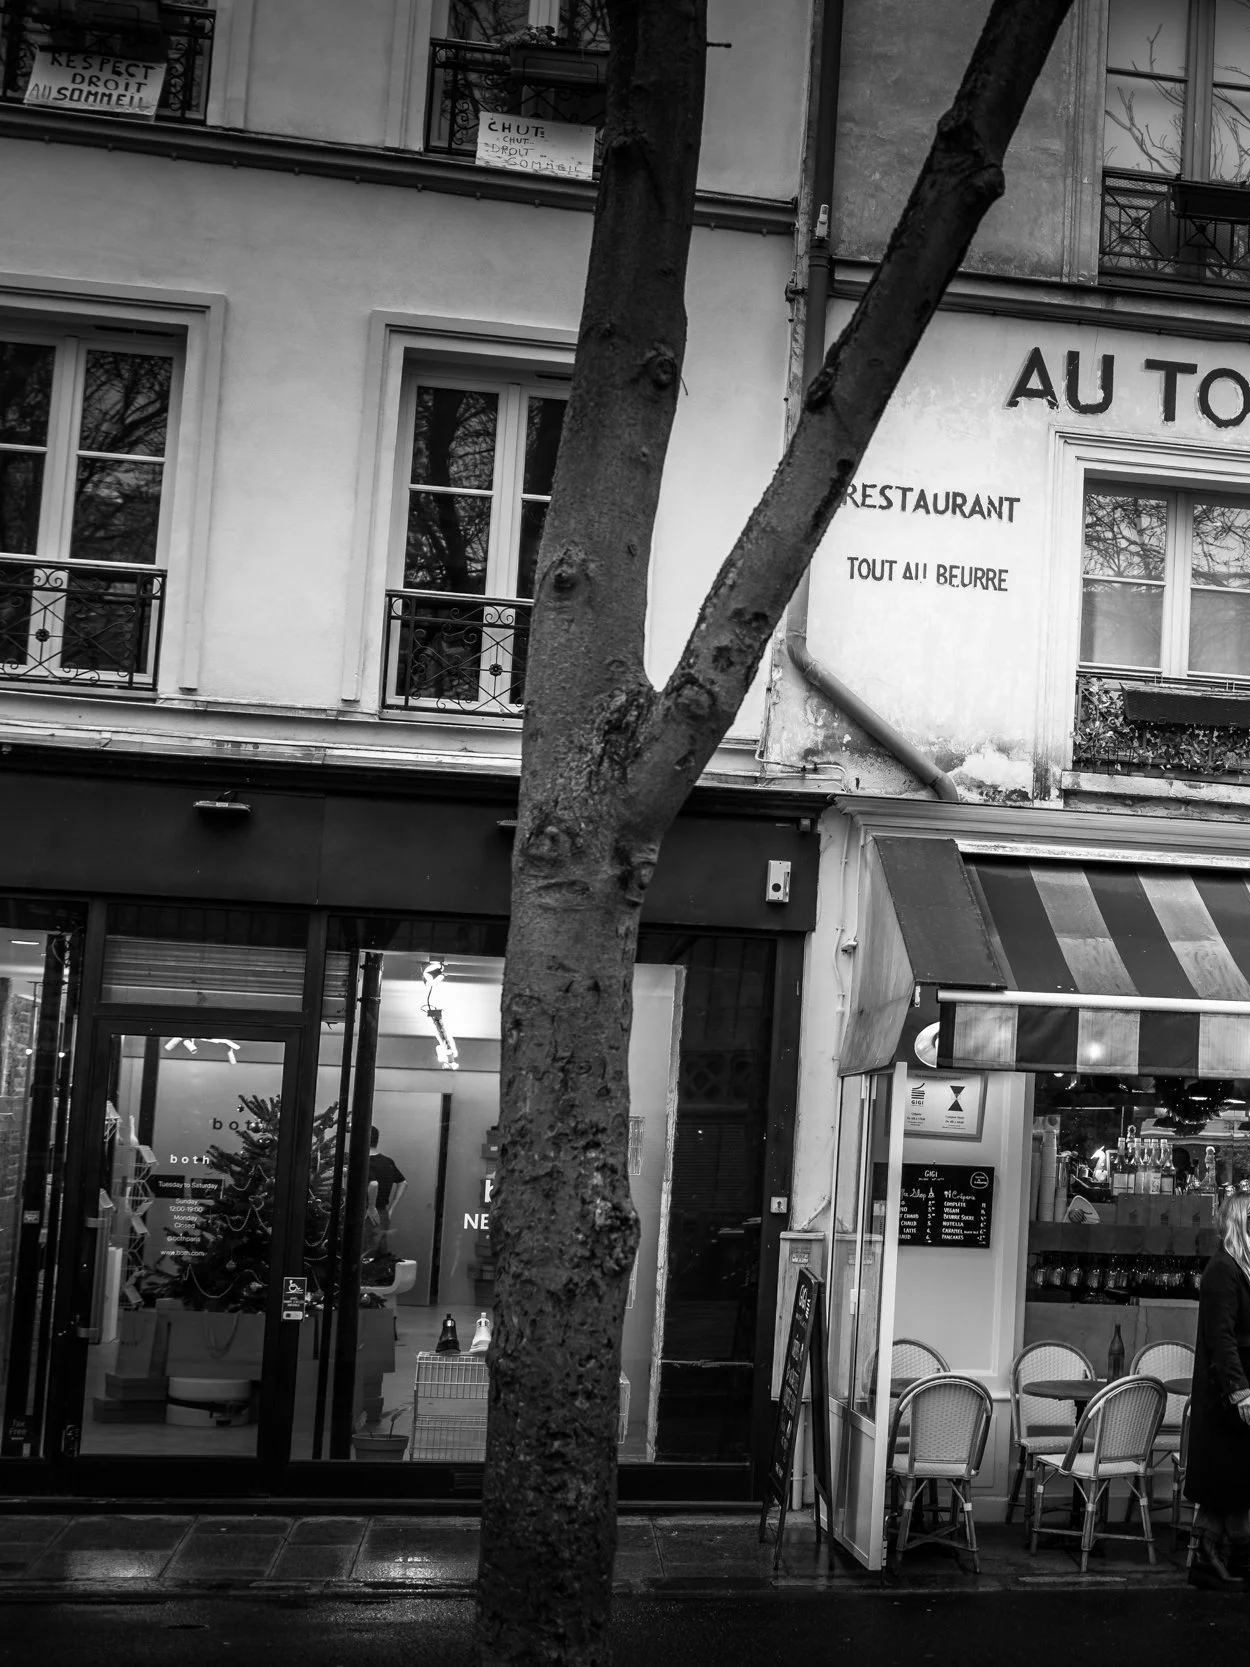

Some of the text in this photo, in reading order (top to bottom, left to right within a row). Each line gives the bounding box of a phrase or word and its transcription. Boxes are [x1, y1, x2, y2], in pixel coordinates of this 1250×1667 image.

[51, 51, 156, 80] RESPECT
[71, 72, 147, 93] DROIT
[29, 83, 156, 110] AU SOMMEIL
[1006, 346, 1115, 415] AU
[842, 482, 1021, 523] RESTAURANT
[847, 556, 897, 582] TOUT
[936, 563, 1009, 592] BEURRE
[212, 1118, 259, 1130] bot
[169, 1154, 210, 1164] both
[924, 1170, 938, 1178] GIGI
[158, 1181, 183, 1189] Tuesday
[191, 1182, 218, 1190] Saturday
[175, 1198, 199, 1206] Sunday
